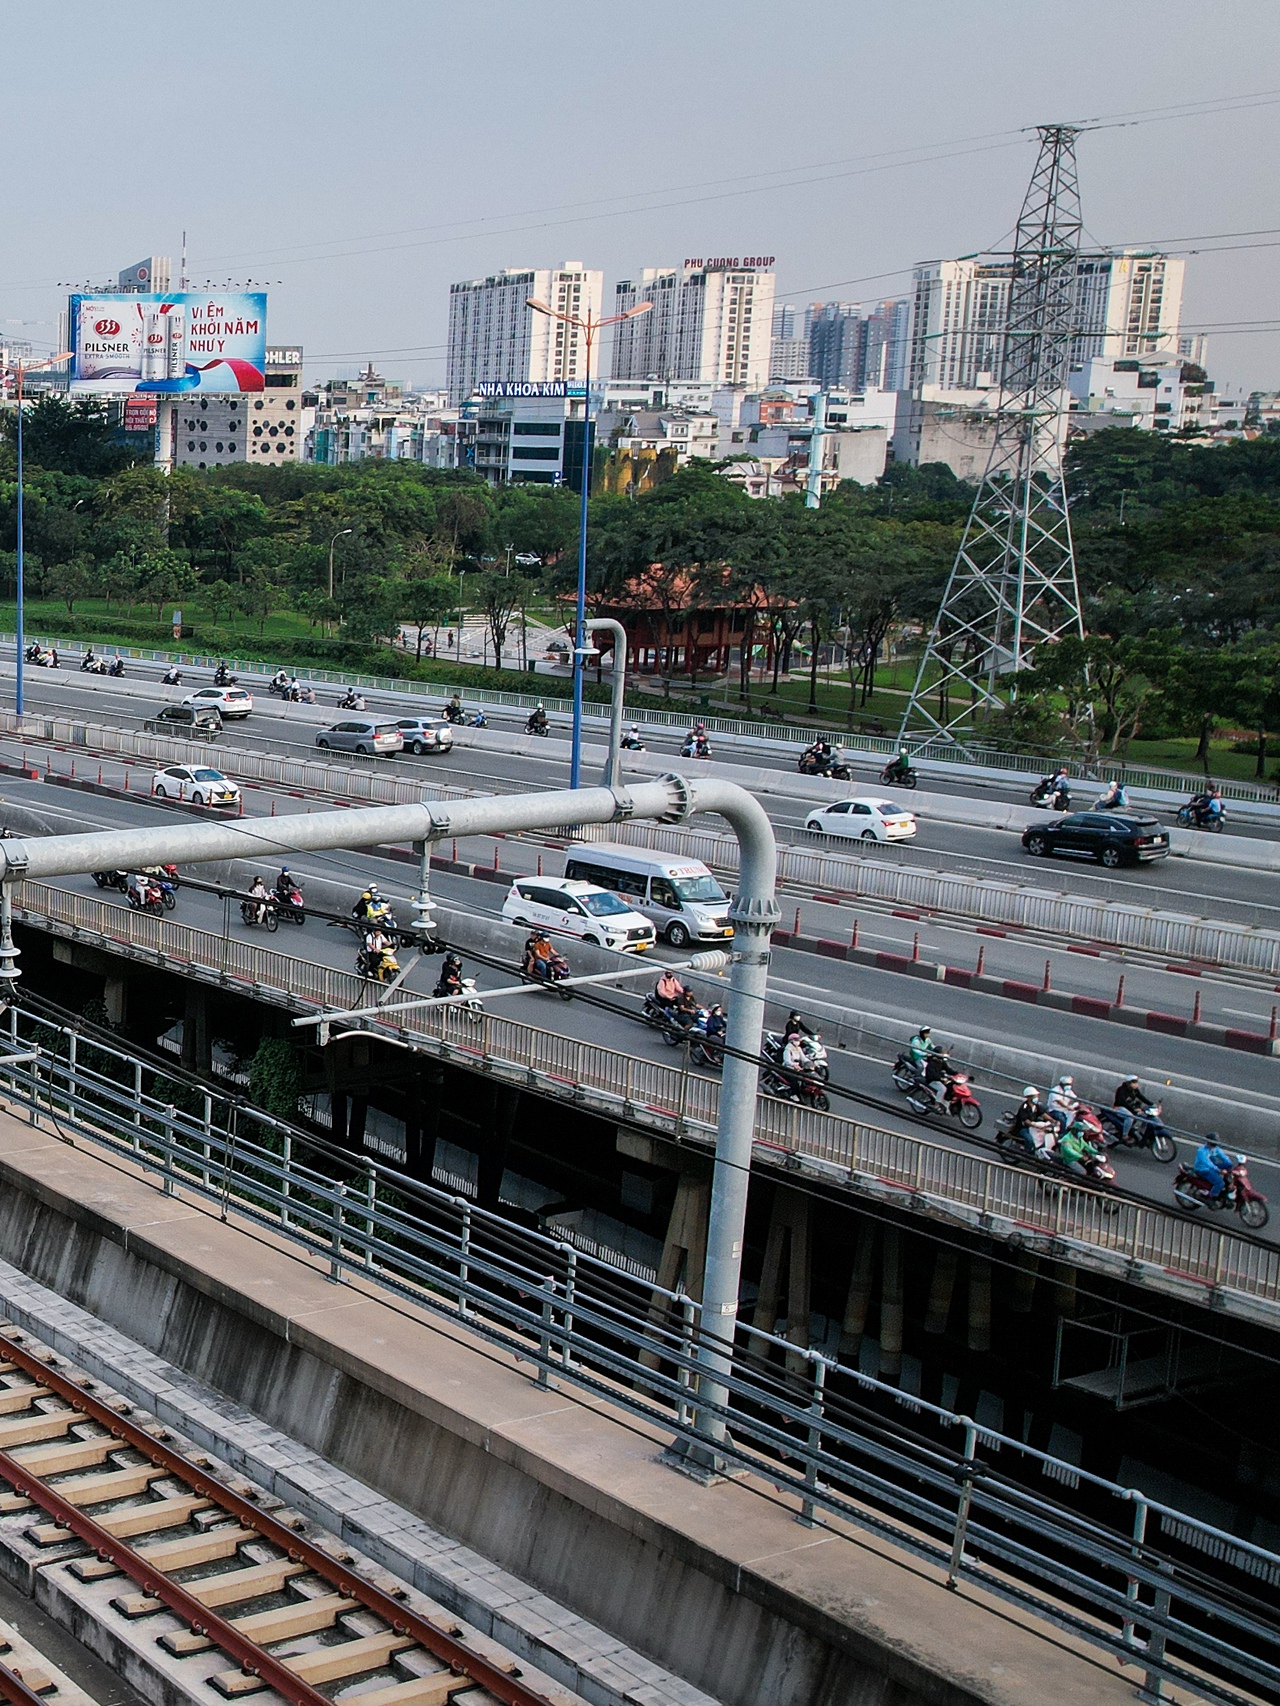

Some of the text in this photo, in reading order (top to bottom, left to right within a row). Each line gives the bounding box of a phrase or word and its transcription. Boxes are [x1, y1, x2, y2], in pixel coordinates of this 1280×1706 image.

[684, 256, 776, 268] PHU CUONG GROUP
[207, 300, 224, 318] ÊM
[97, 319, 116, 334] 333
[191, 317, 259, 335] KHỞI NĂM
[84, 343, 130, 353] PILSNER
[190, 337, 216, 353] NHƯ
[479, 382, 504, 397] NHA
[506, 382, 540, 397] KHOA
[542, 382, 565, 396] KIM
